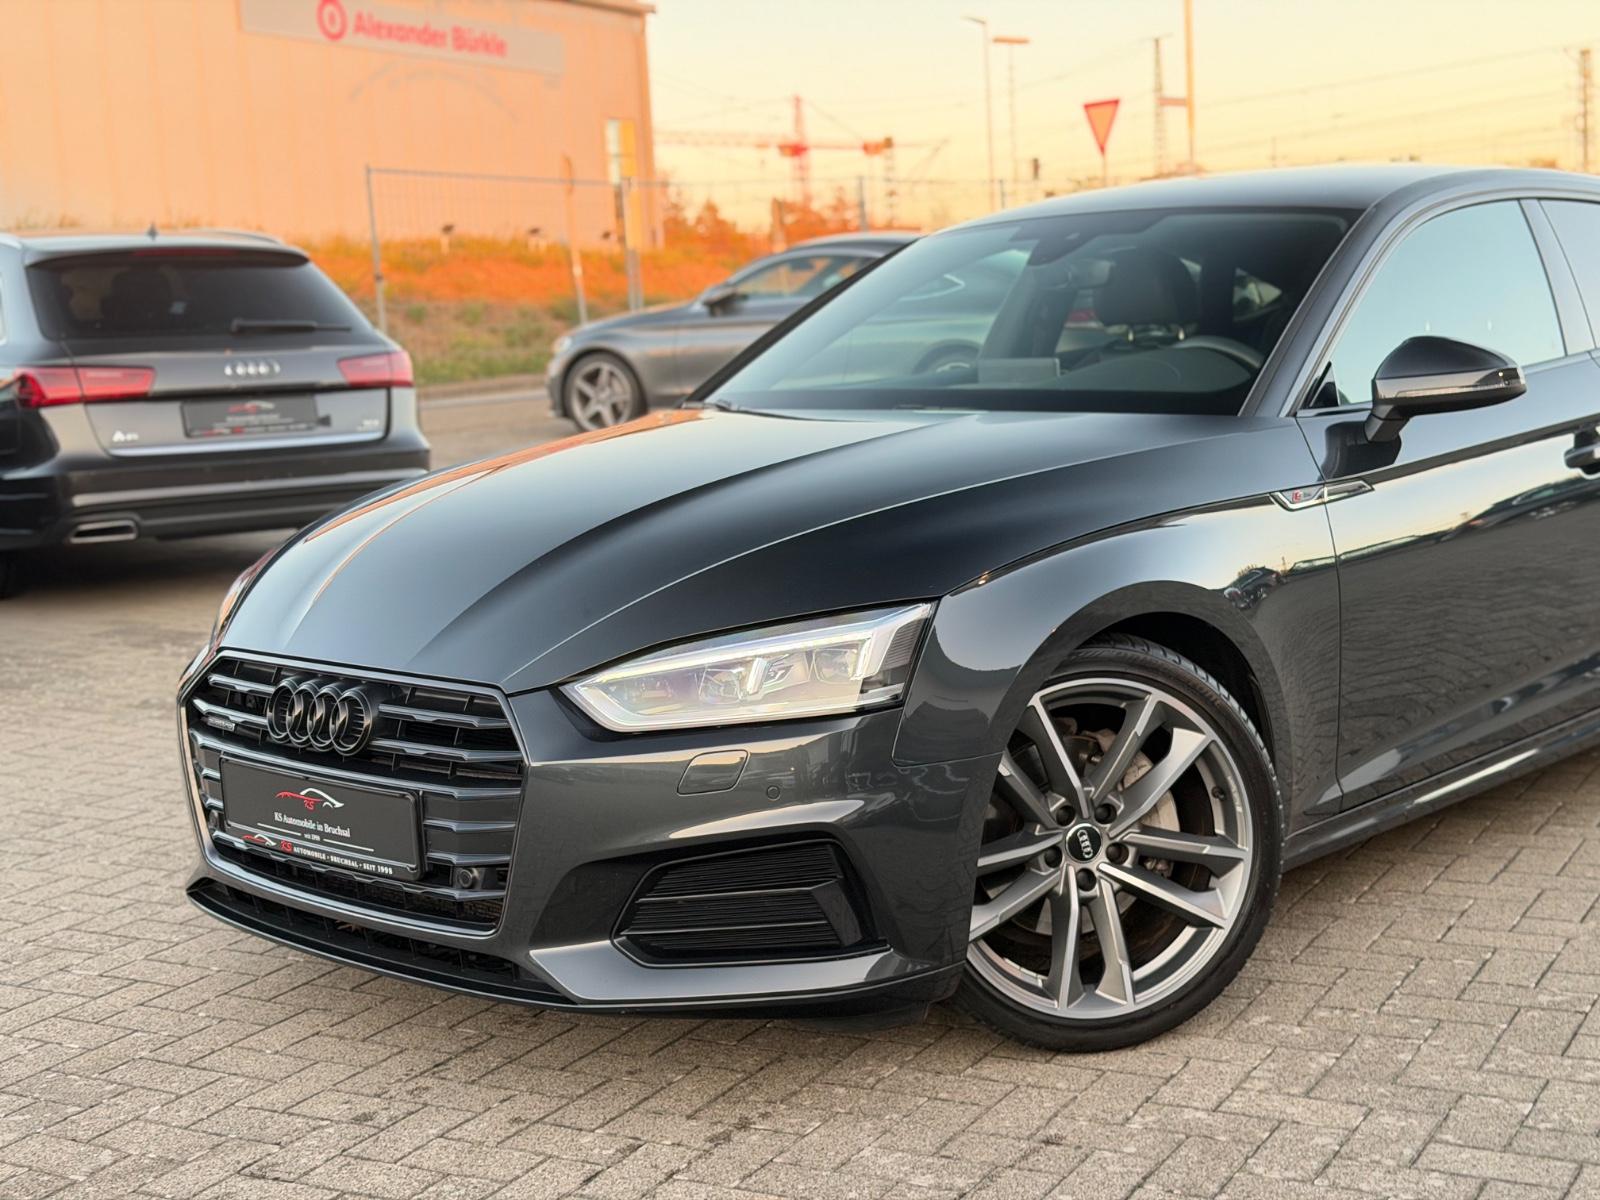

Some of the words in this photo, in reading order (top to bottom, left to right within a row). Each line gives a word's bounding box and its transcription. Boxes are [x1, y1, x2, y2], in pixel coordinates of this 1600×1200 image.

[354, 11, 447, 47] Alexander
[274, 811, 283, 821] KS
[283, 814, 316, 829] Automobile
[316, 821, 323, 831] in
[324, 823, 350, 837] Bruchsal
[294, 846, 326, 860] AUTOMOBILE
[330, 855, 358, 868] BRUCHSAL
[363, 862, 376, 871] SEIT
